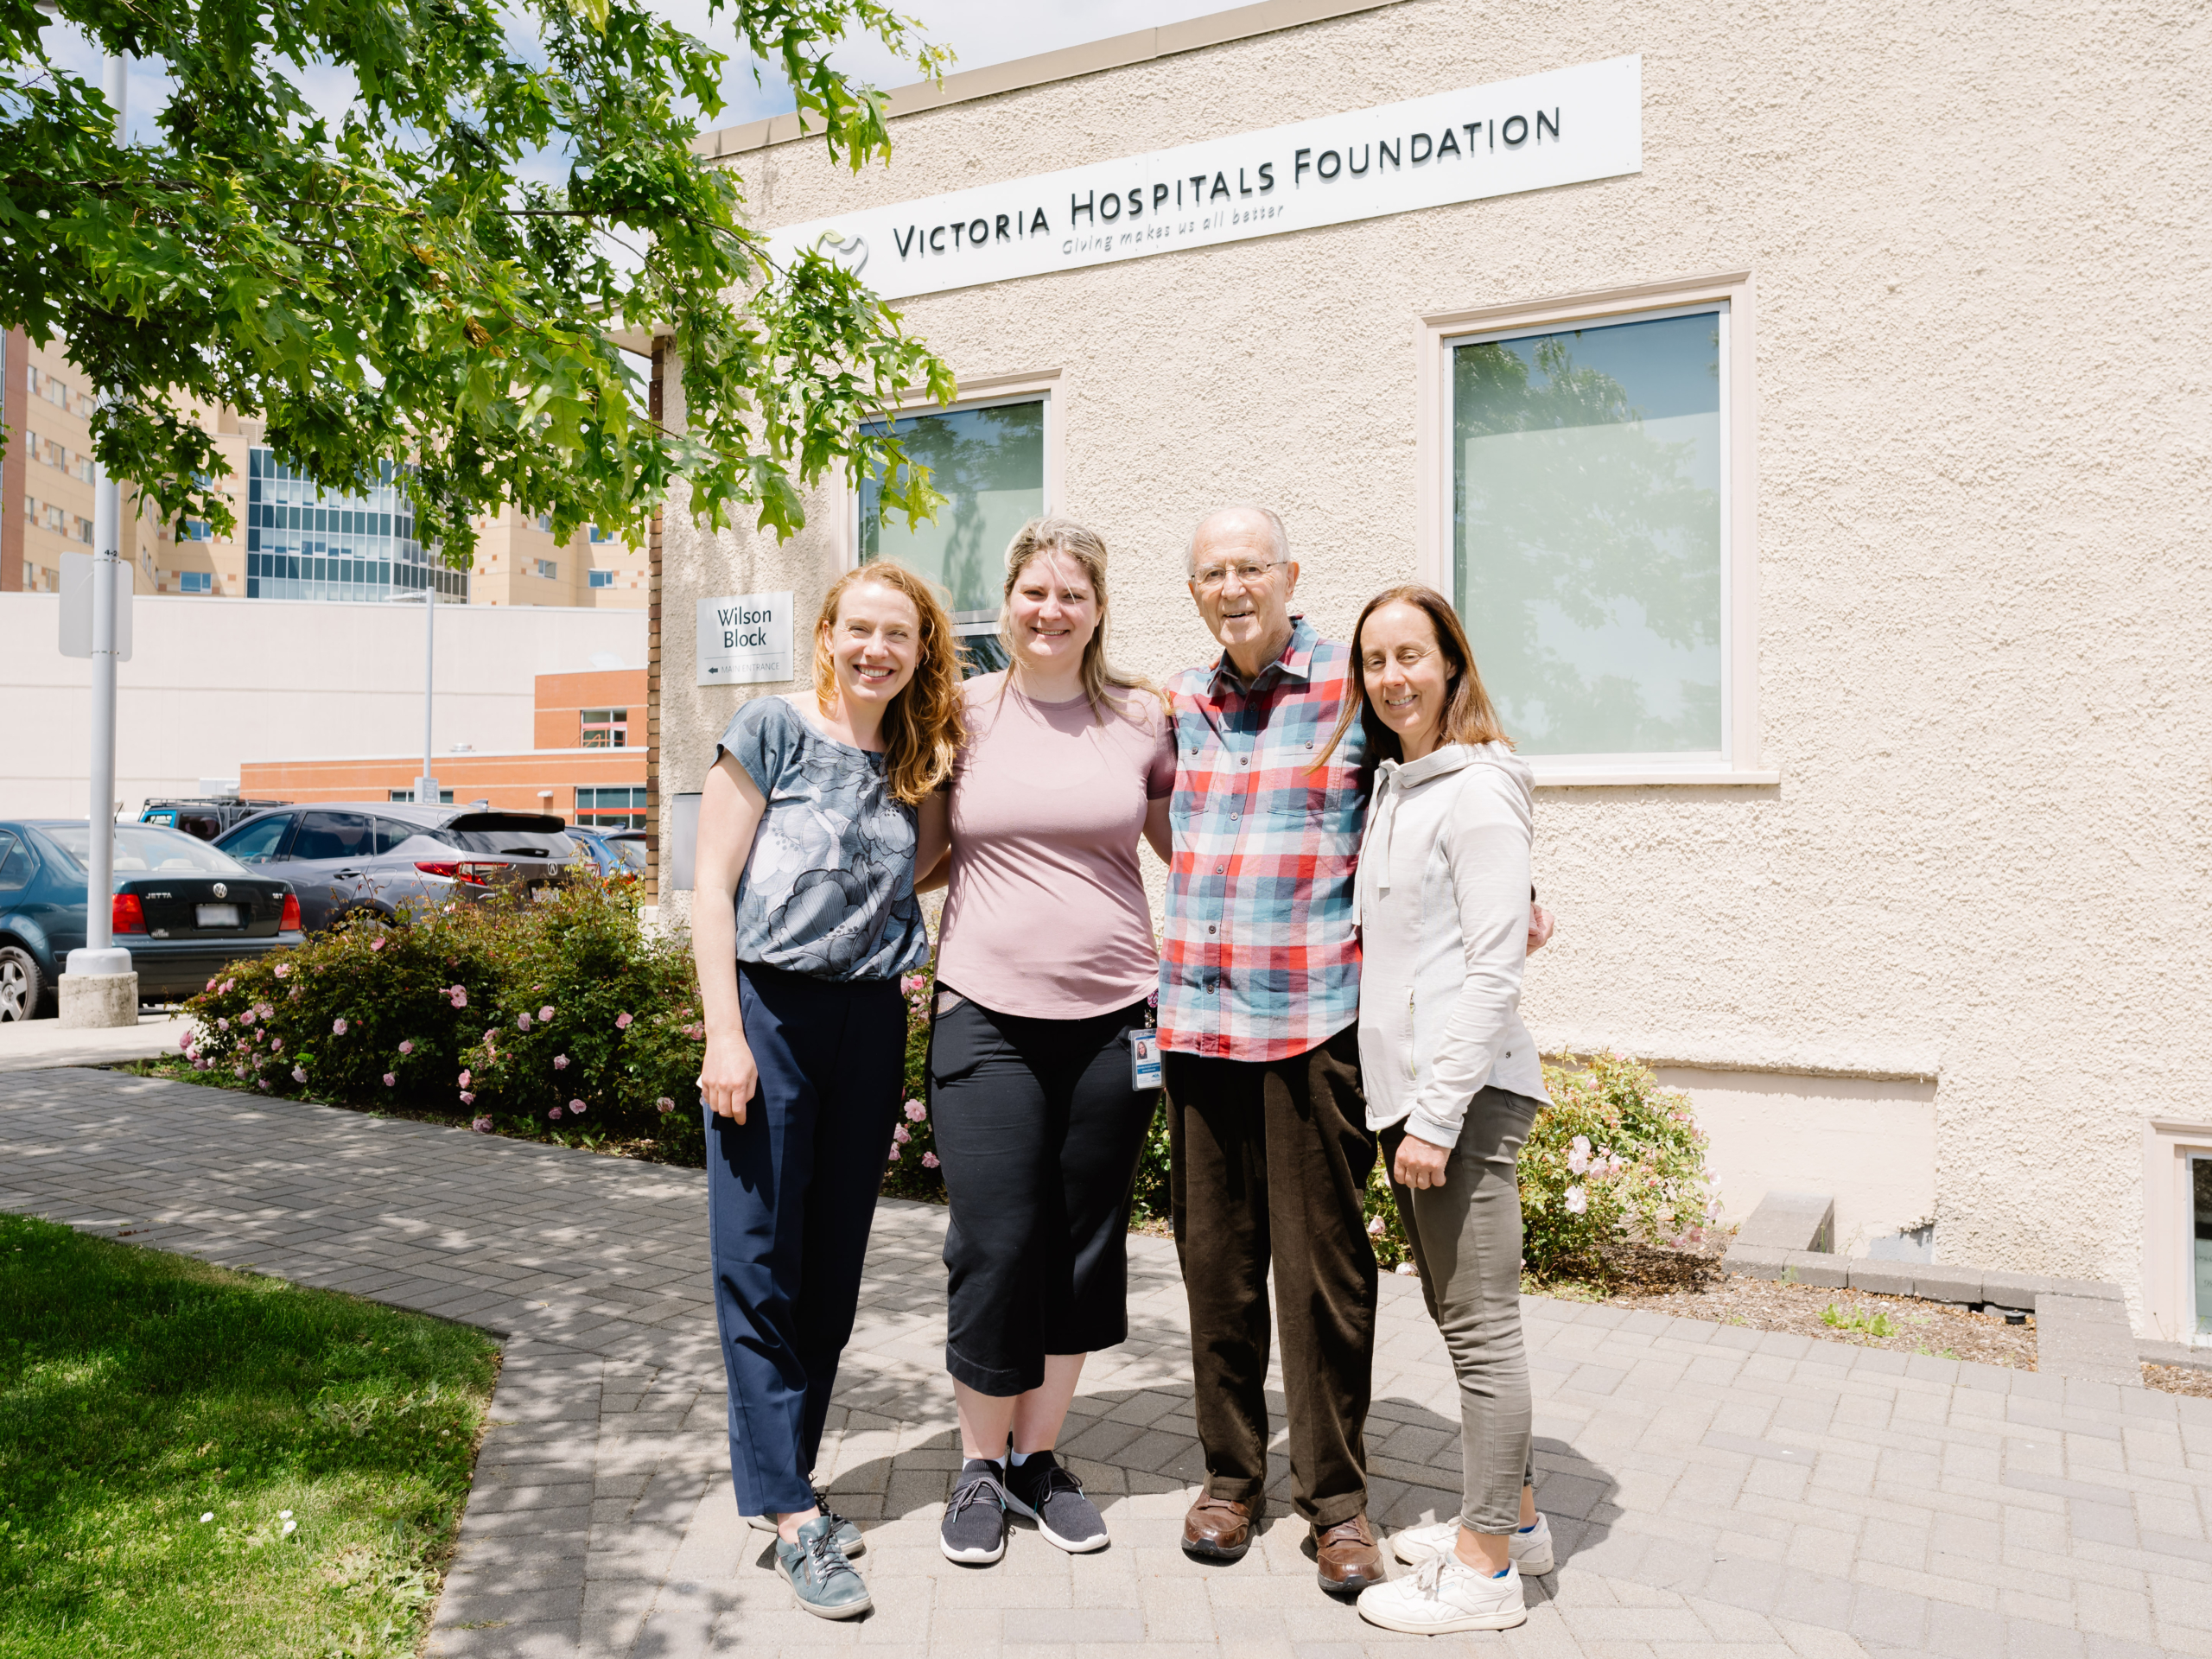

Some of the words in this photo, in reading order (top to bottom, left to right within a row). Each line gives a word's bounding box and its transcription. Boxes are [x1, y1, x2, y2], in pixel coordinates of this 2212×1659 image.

[893, 207, 1050, 258] VICTORIA
[1071, 162, 1274, 226] HOSPITALS
[1294, 106, 1560, 184] FOUNDATION
[1062, 235, 1112, 255] Giving
[1120, 223, 1170, 245] makes
[1179, 219, 1195, 235] us
[1203, 210, 1224, 231] all
[1232, 204, 1284, 226] better
[717, 606, 772, 626] Wilson
[724, 626, 766, 649] Block
[721, 664, 741, 674] MAIN
[742, 662, 780, 672] ENTRANCE
